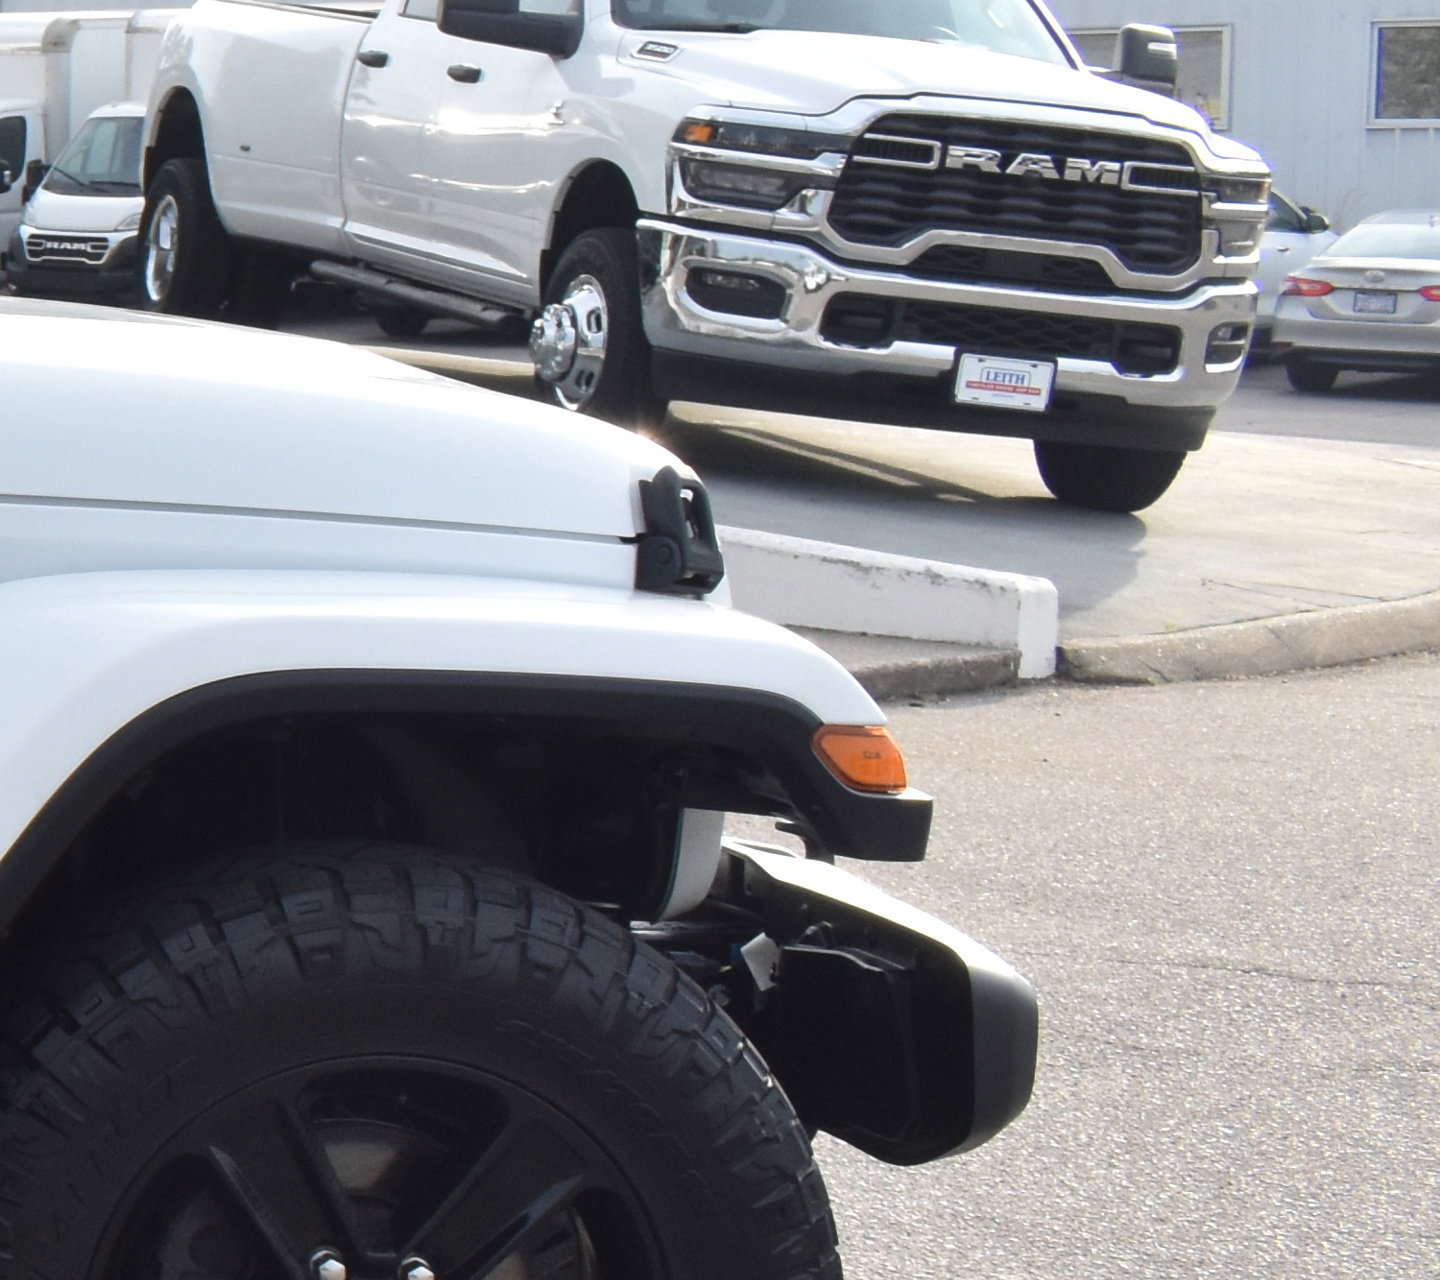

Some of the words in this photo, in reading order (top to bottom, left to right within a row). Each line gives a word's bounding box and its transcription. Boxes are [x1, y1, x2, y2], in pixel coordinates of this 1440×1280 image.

[945, 144, 1122, 186] RAM
[45, 240, 87, 250] RAM
[986, 370, 1026, 385] LEITH
